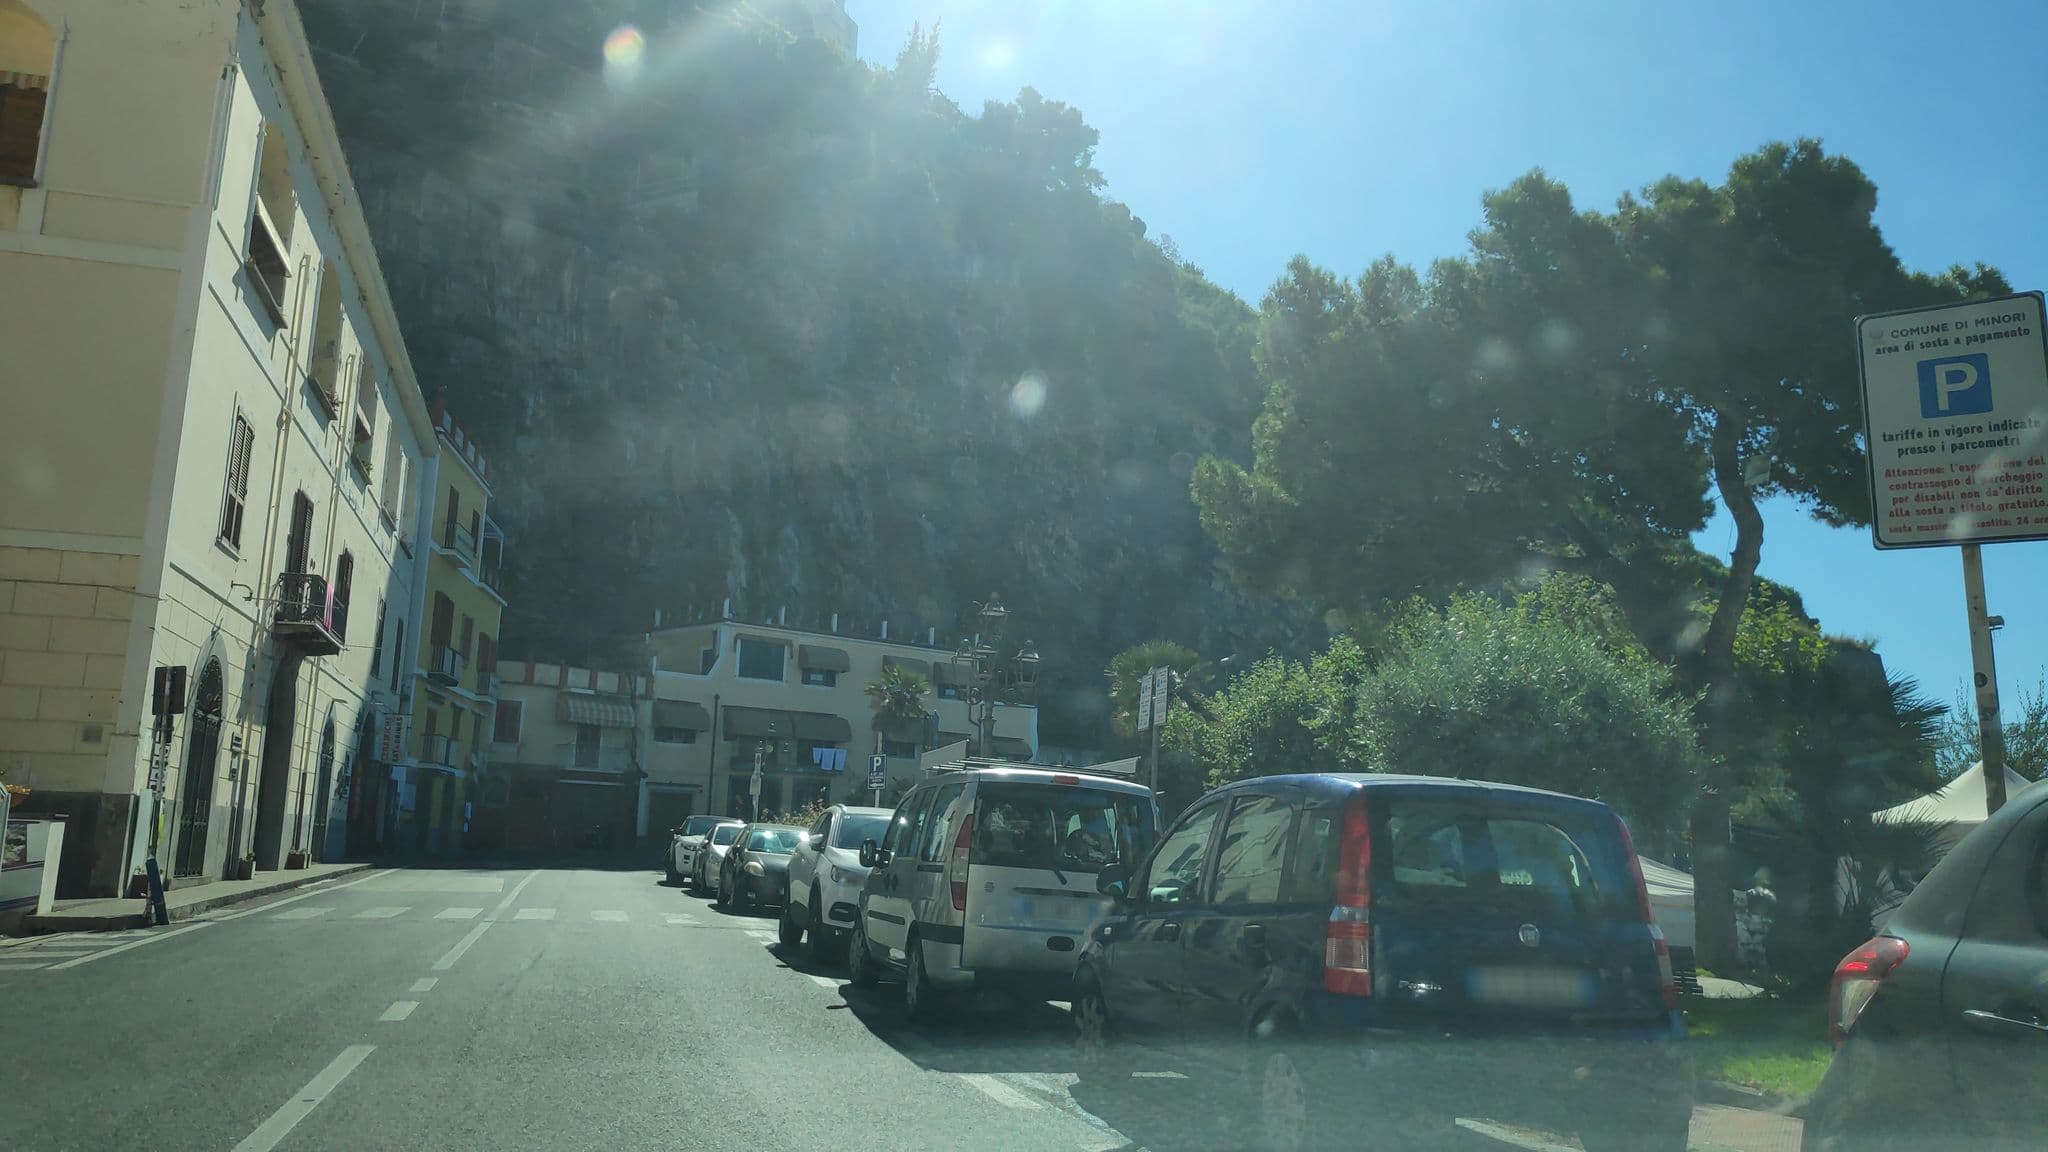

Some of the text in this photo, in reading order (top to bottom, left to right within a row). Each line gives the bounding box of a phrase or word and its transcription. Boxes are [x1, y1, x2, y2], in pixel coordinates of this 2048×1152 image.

[1891, 312, 2026, 338] COMUNE DI MINORI
[1875, 327, 2030, 355] area di sosta a pagamento
[1935, 363, 1978, 411] P
[1882, 428, 1923, 442] tariffe
[1928, 427, 1940, 438] in
[1945, 425, 1983, 438] vigore
[1898, 435, 2020, 458] presso i parcometri
[1981, 471, 2043, 486] rcheggio
[873, 756, 882, 772] P
